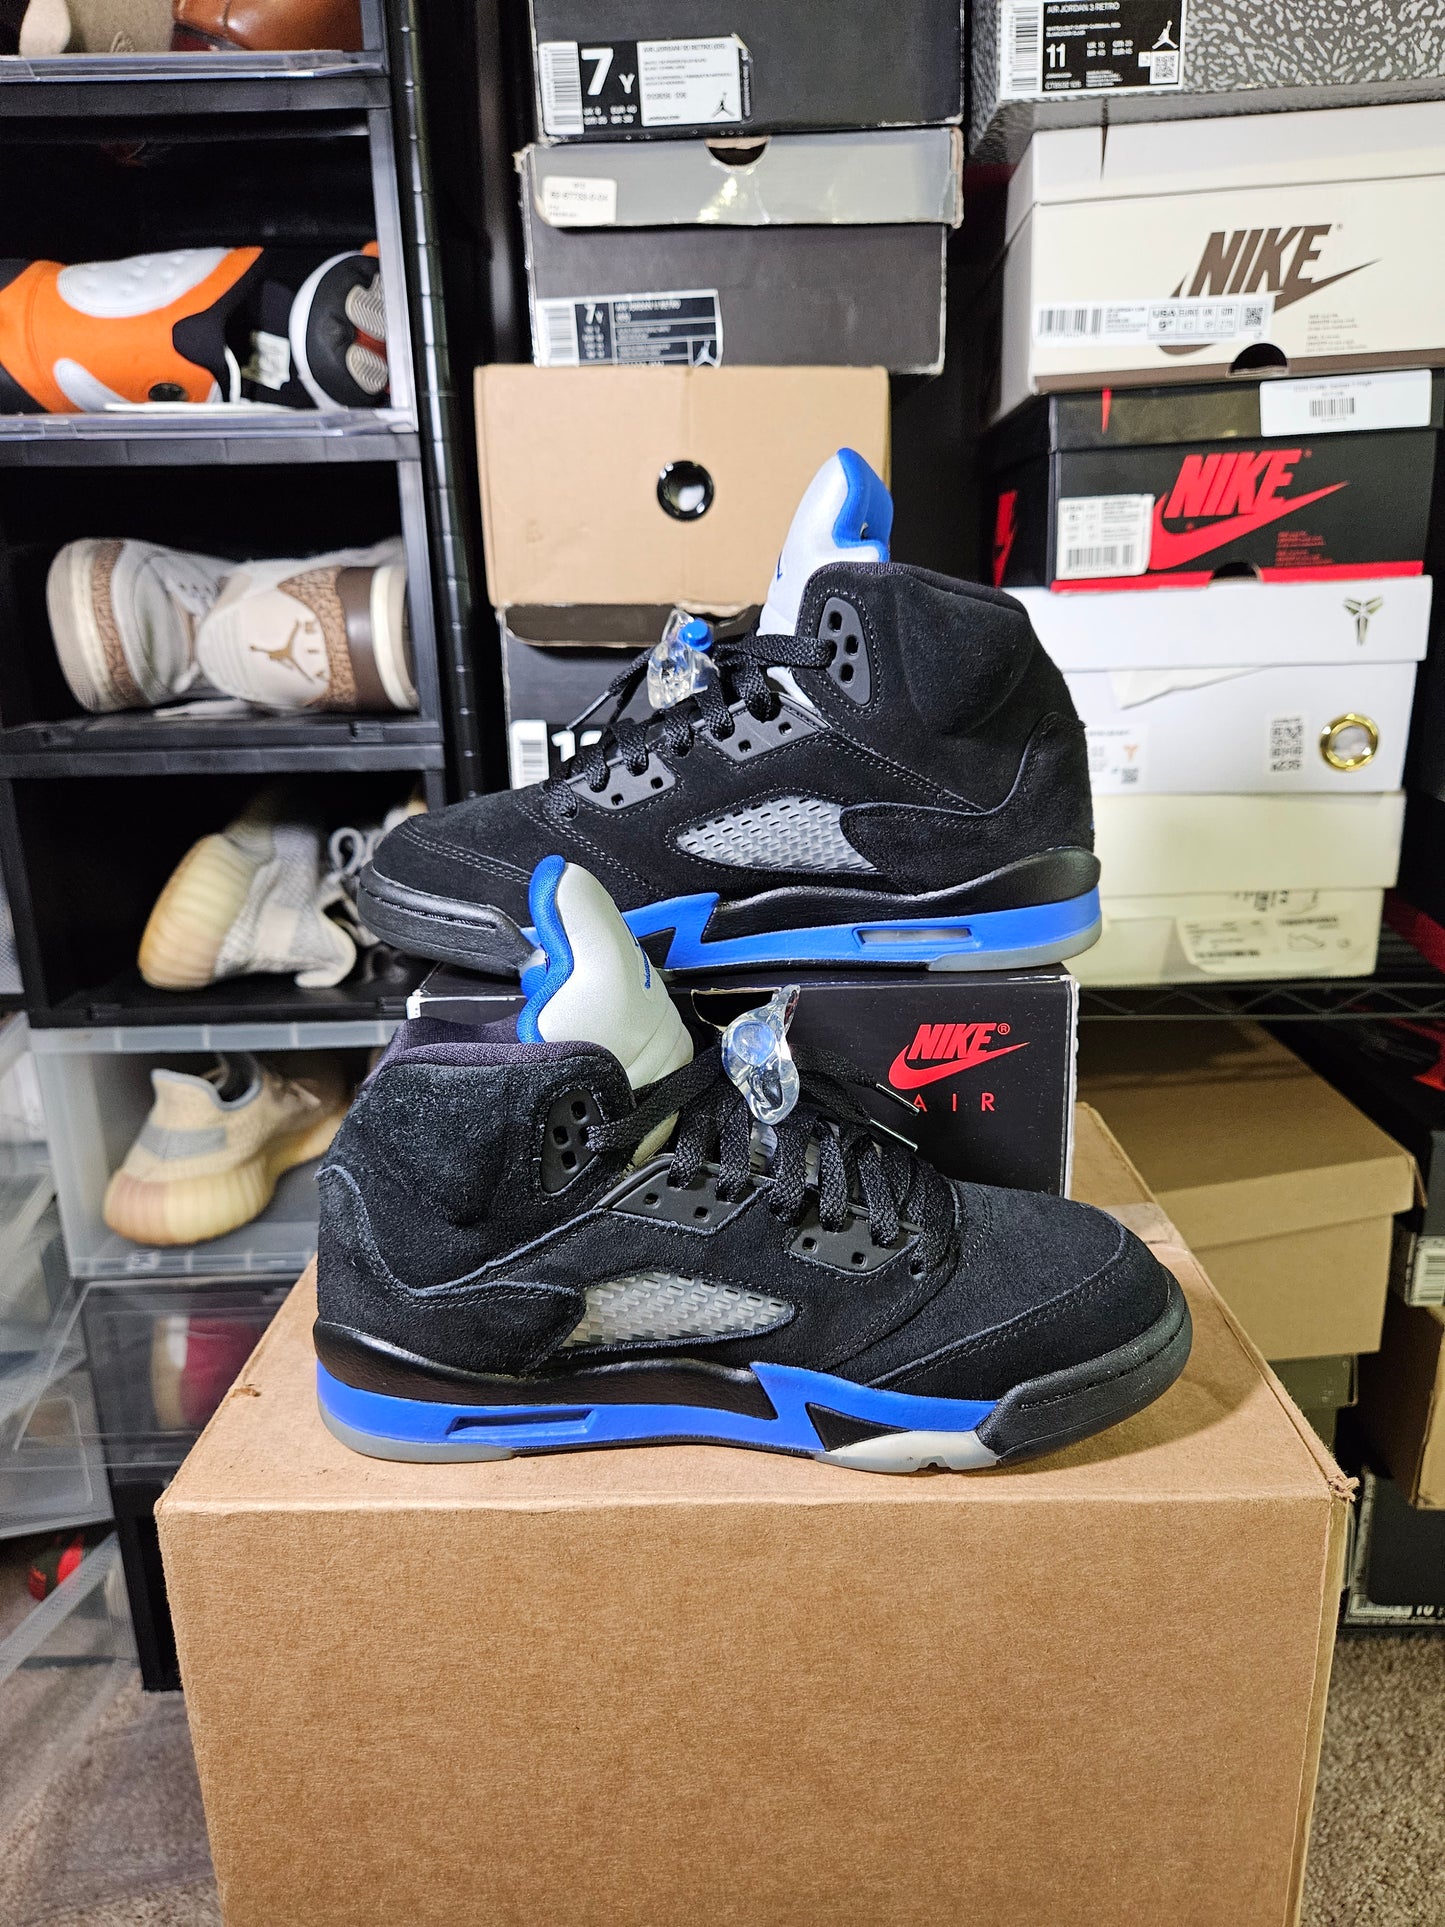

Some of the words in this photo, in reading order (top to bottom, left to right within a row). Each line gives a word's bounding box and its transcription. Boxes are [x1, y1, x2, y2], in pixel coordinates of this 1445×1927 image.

[1060, 3, 1089, 13] JORDAN
[1095, 1, 1121, 11] RETRO
[580, 47, 614, 96] 7
[618, 72, 636, 94] Y
[1045, 42, 1066, 68] 11
[1187, 224, 1332, 298] NIKE
[1163, 448, 1302, 519] NIKE
[906, 1022, 998, 1060] NIKE
[913, 1092, 995, 1112] AIR
